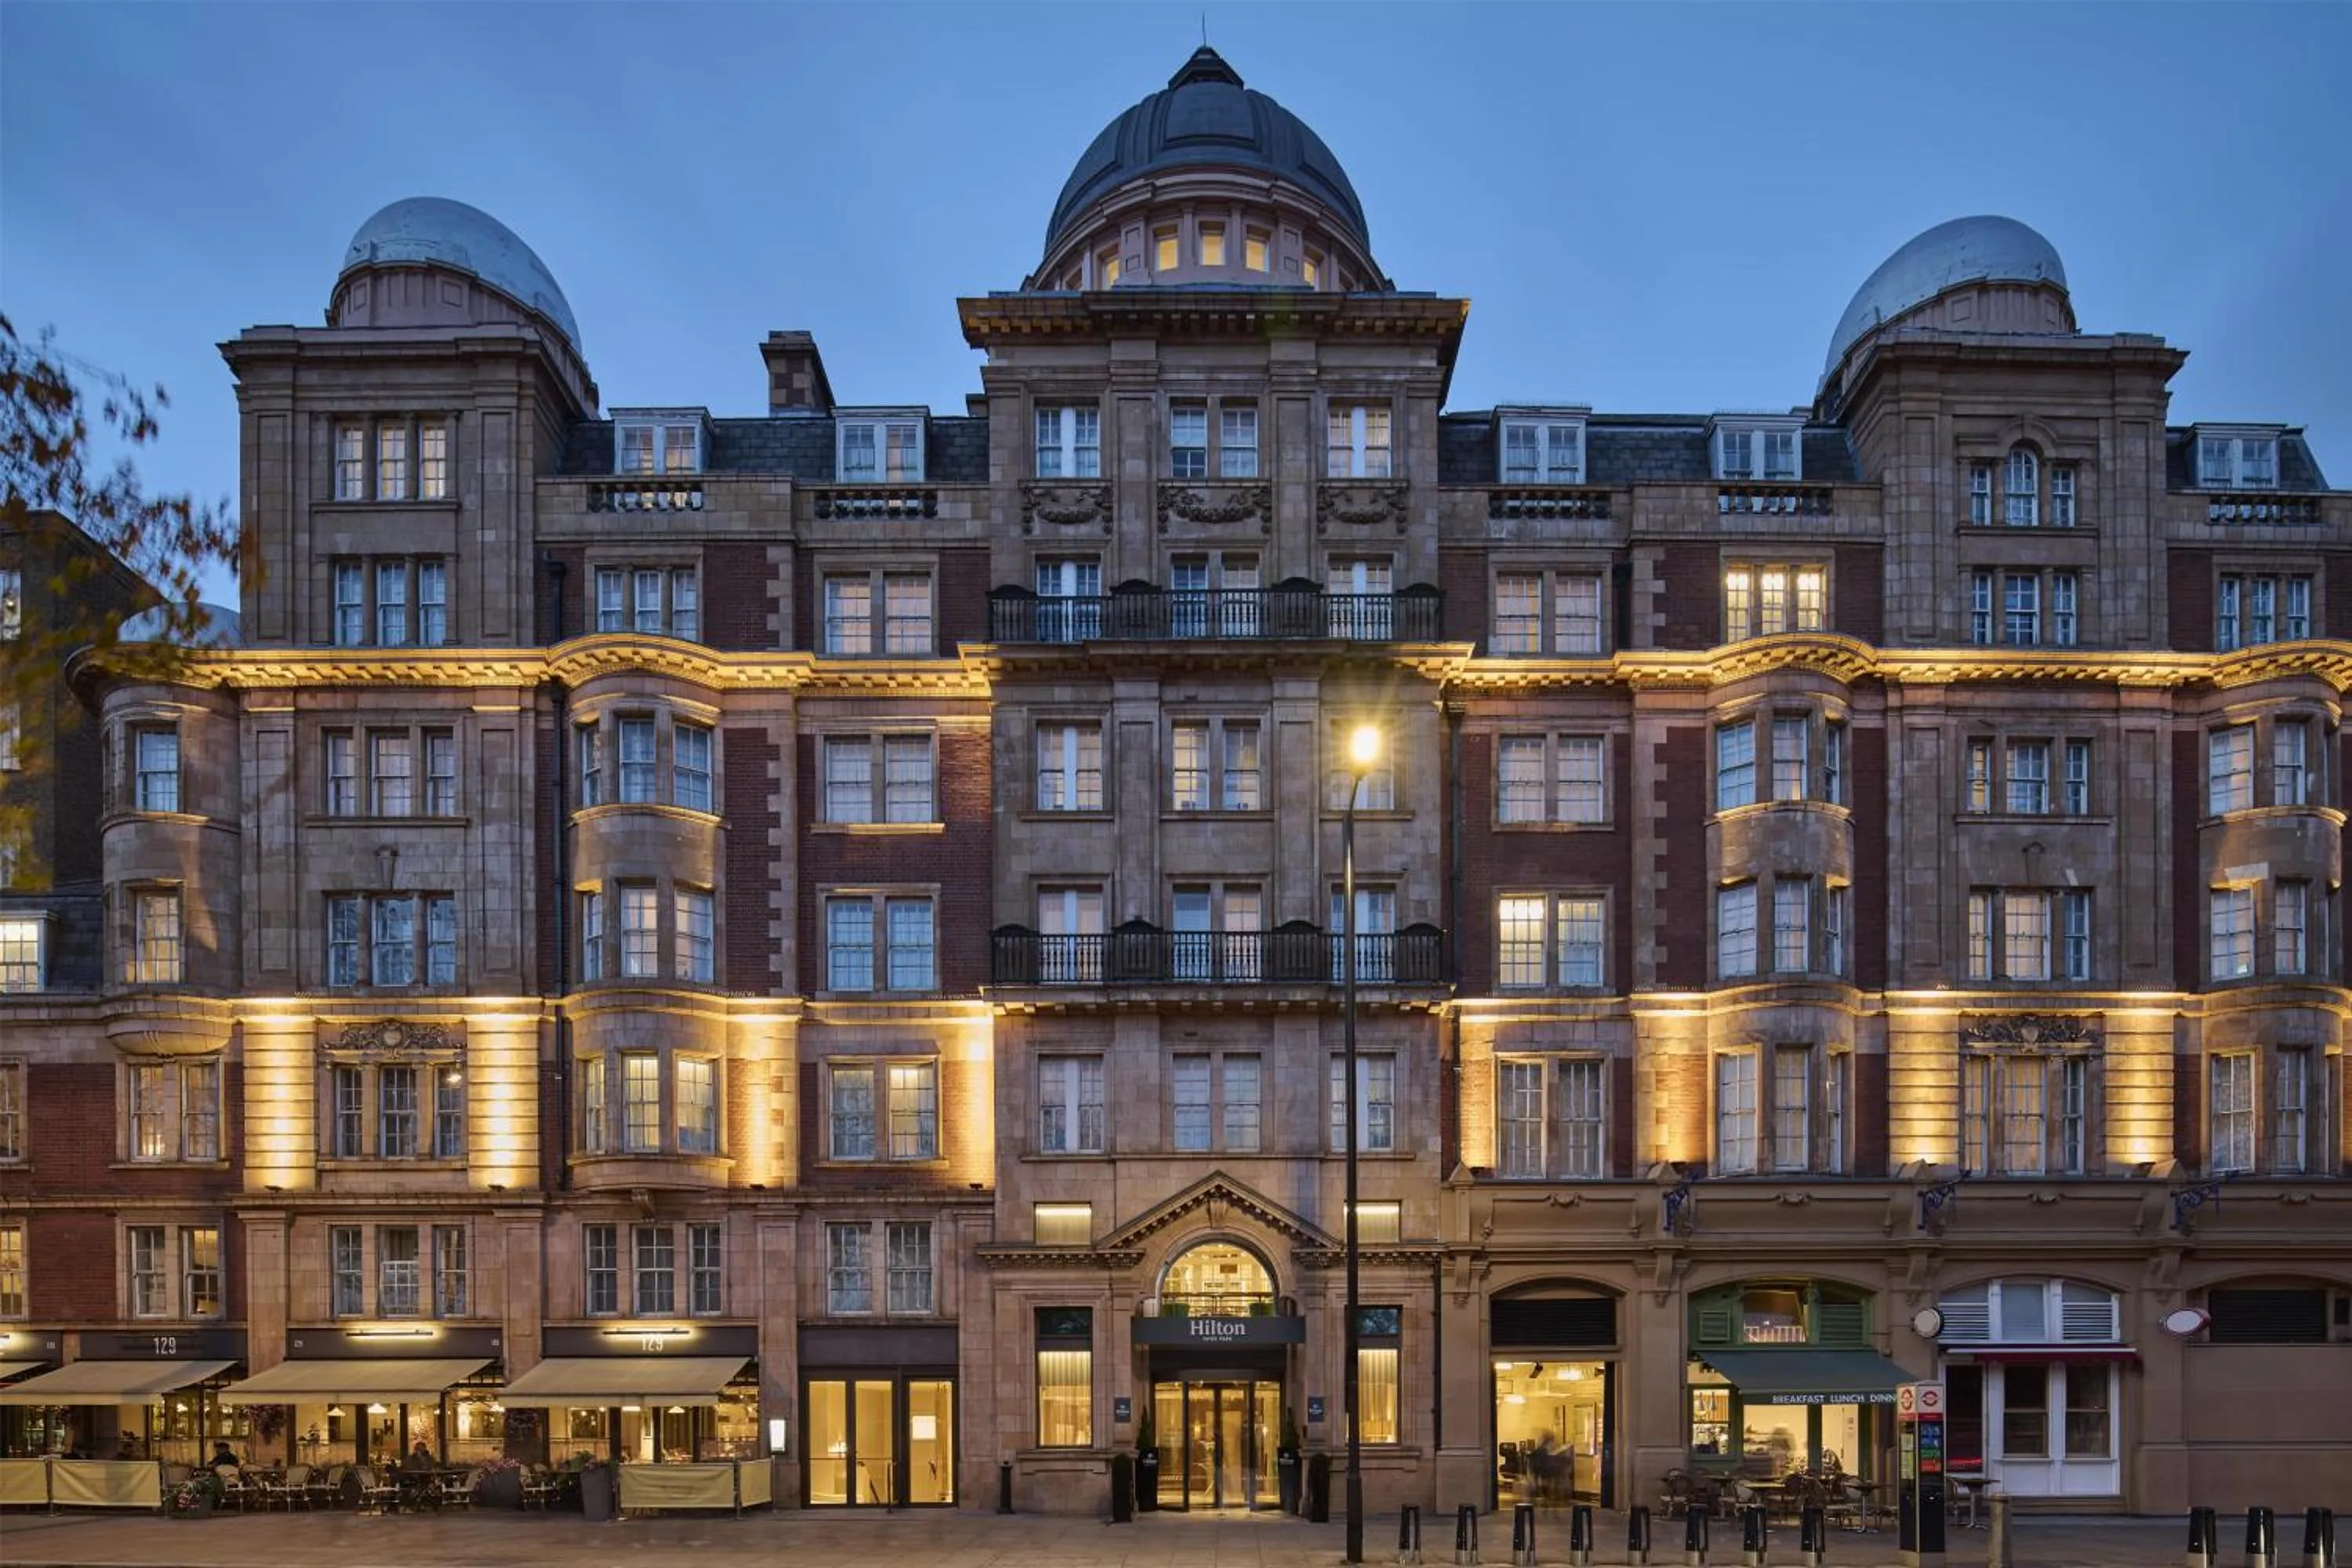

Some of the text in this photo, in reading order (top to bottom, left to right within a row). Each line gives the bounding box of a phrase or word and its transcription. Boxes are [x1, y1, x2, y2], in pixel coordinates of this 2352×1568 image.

[1191, 1319, 1246, 1335] Hilton
[153, 1337, 176, 1355] 129
[1773, 1395, 1825, 1403] BREAKFAST
[1830, 1394, 1865, 1403] LUNCH
